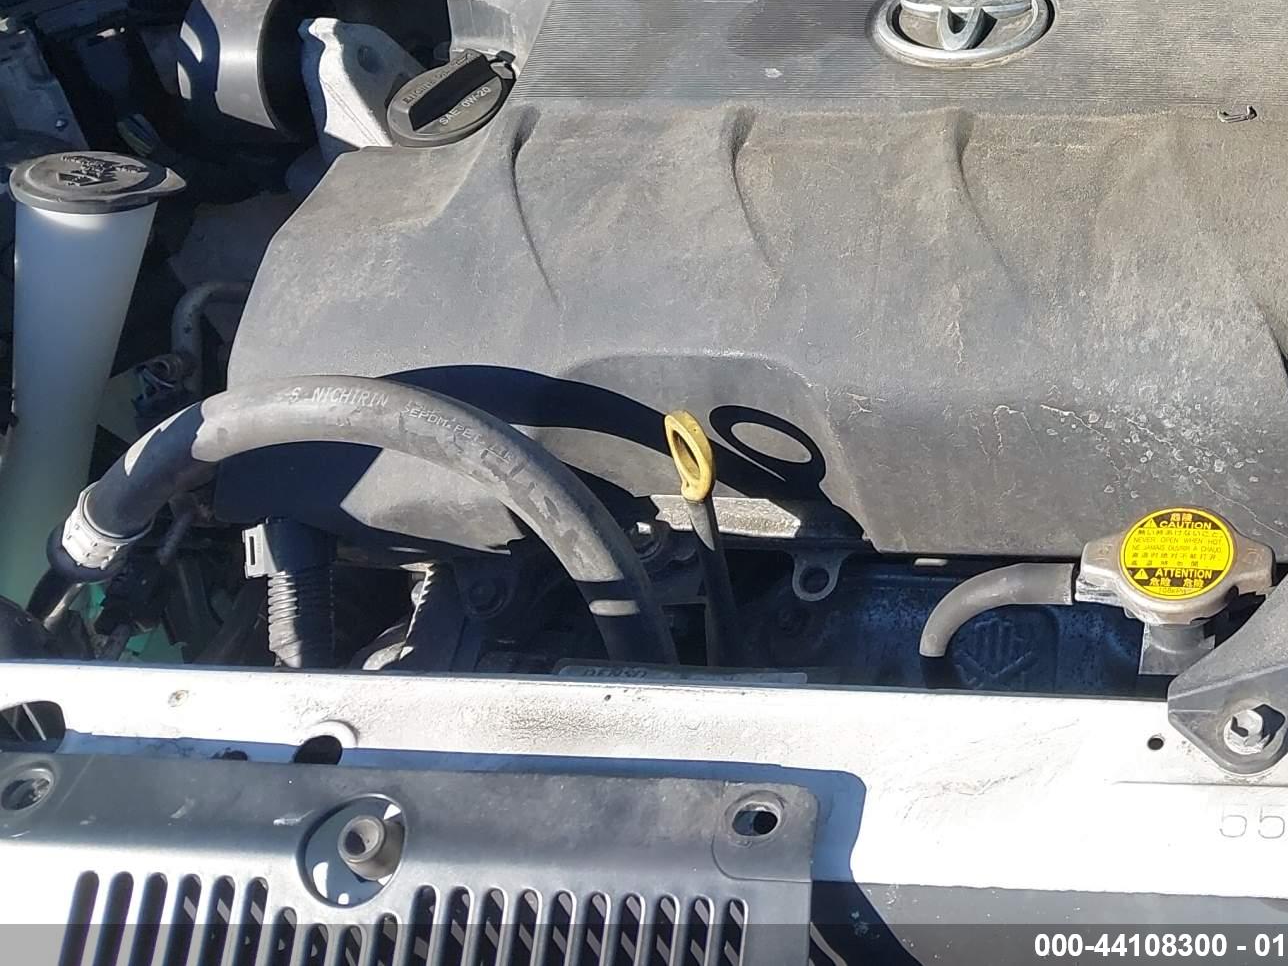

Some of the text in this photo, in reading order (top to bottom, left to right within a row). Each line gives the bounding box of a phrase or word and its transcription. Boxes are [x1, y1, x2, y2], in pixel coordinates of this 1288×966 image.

[439, 108, 461, 125] SAE
[312, 386, 390, 407] NICHIRIN
[1159, 520, 1212, 529] CAUTION
[1155, 568, 1213, 579] ATTENTION
